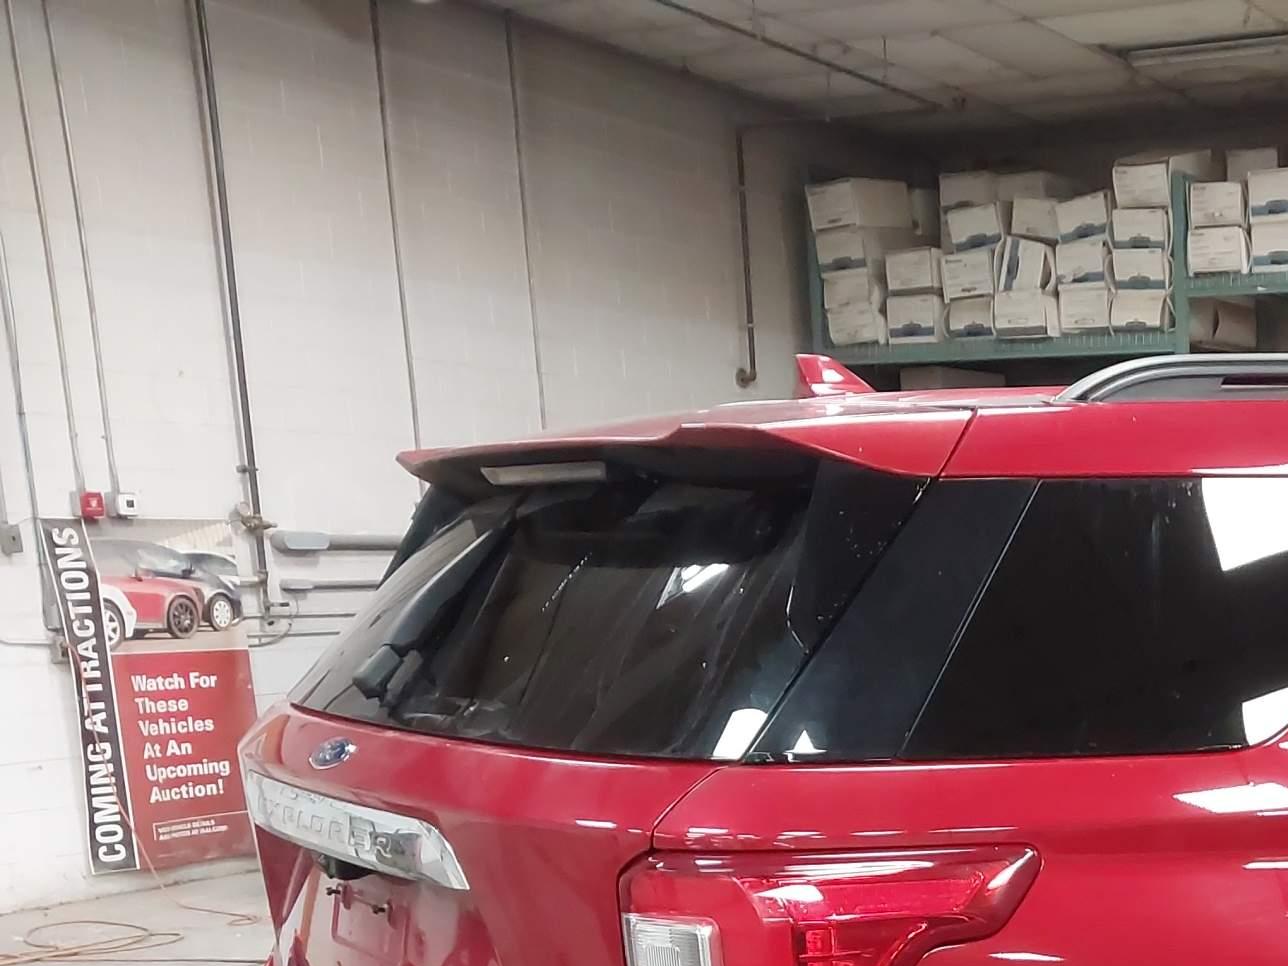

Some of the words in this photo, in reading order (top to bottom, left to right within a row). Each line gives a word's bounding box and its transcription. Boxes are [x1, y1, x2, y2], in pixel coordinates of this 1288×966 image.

[52, 526, 109, 734] ATTRACTIONS
[131, 673, 185, 692] Watch
[189, 671, 217, 689] For
[134, 697, 188, 714] These
[138, 716, 215, 736] Vehicles
[143, 741, 162, 760] At
[166, 739, 193, 756] An
[145, 758, 231, 784] Upcoming
[87, 741, 127, 862] COMING
[149, 778, 225, 804] Auction!
